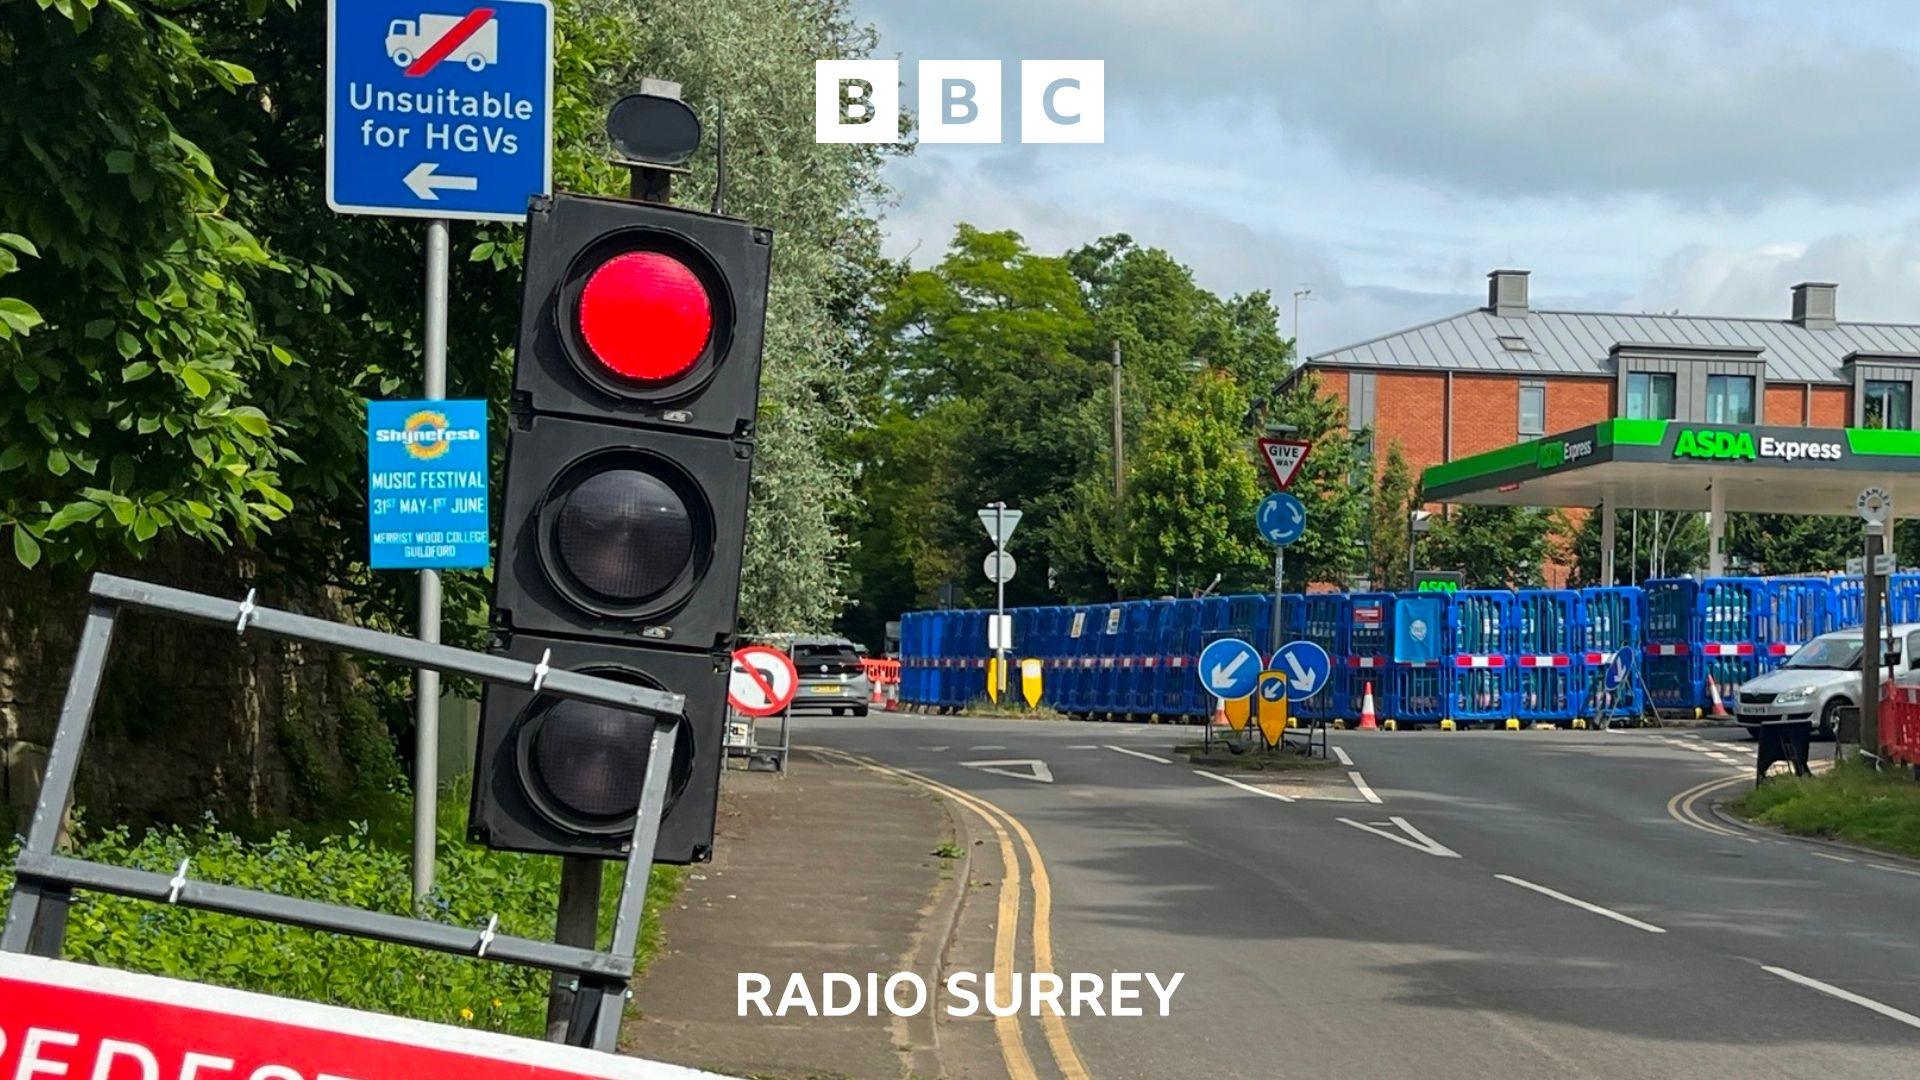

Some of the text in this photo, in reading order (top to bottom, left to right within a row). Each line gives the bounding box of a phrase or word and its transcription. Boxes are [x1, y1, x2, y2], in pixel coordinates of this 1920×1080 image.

[350, 82, 533, 120] Unsuitable
[361, 119, 518, 154] for HGVs
[376, 428, 480, 444] Shynefest
[1675, 429, 1842, 460] ASDA Express
[1269, 446, 1299, 457] GIVE
[1564, 440, 1592, 462] Express
[372, 471, 485, 489] MUSIC FESTIVAL
[374, 498, 396, 514] 31ST
[451, 498, 484, 513] JUNE
[1858, 488, 1891, 508] BRAMLEY
[373, 531, 487, 544] MERRIST WOOD COLLEGE
[404, 545, 456, 557] GUILDFORD
